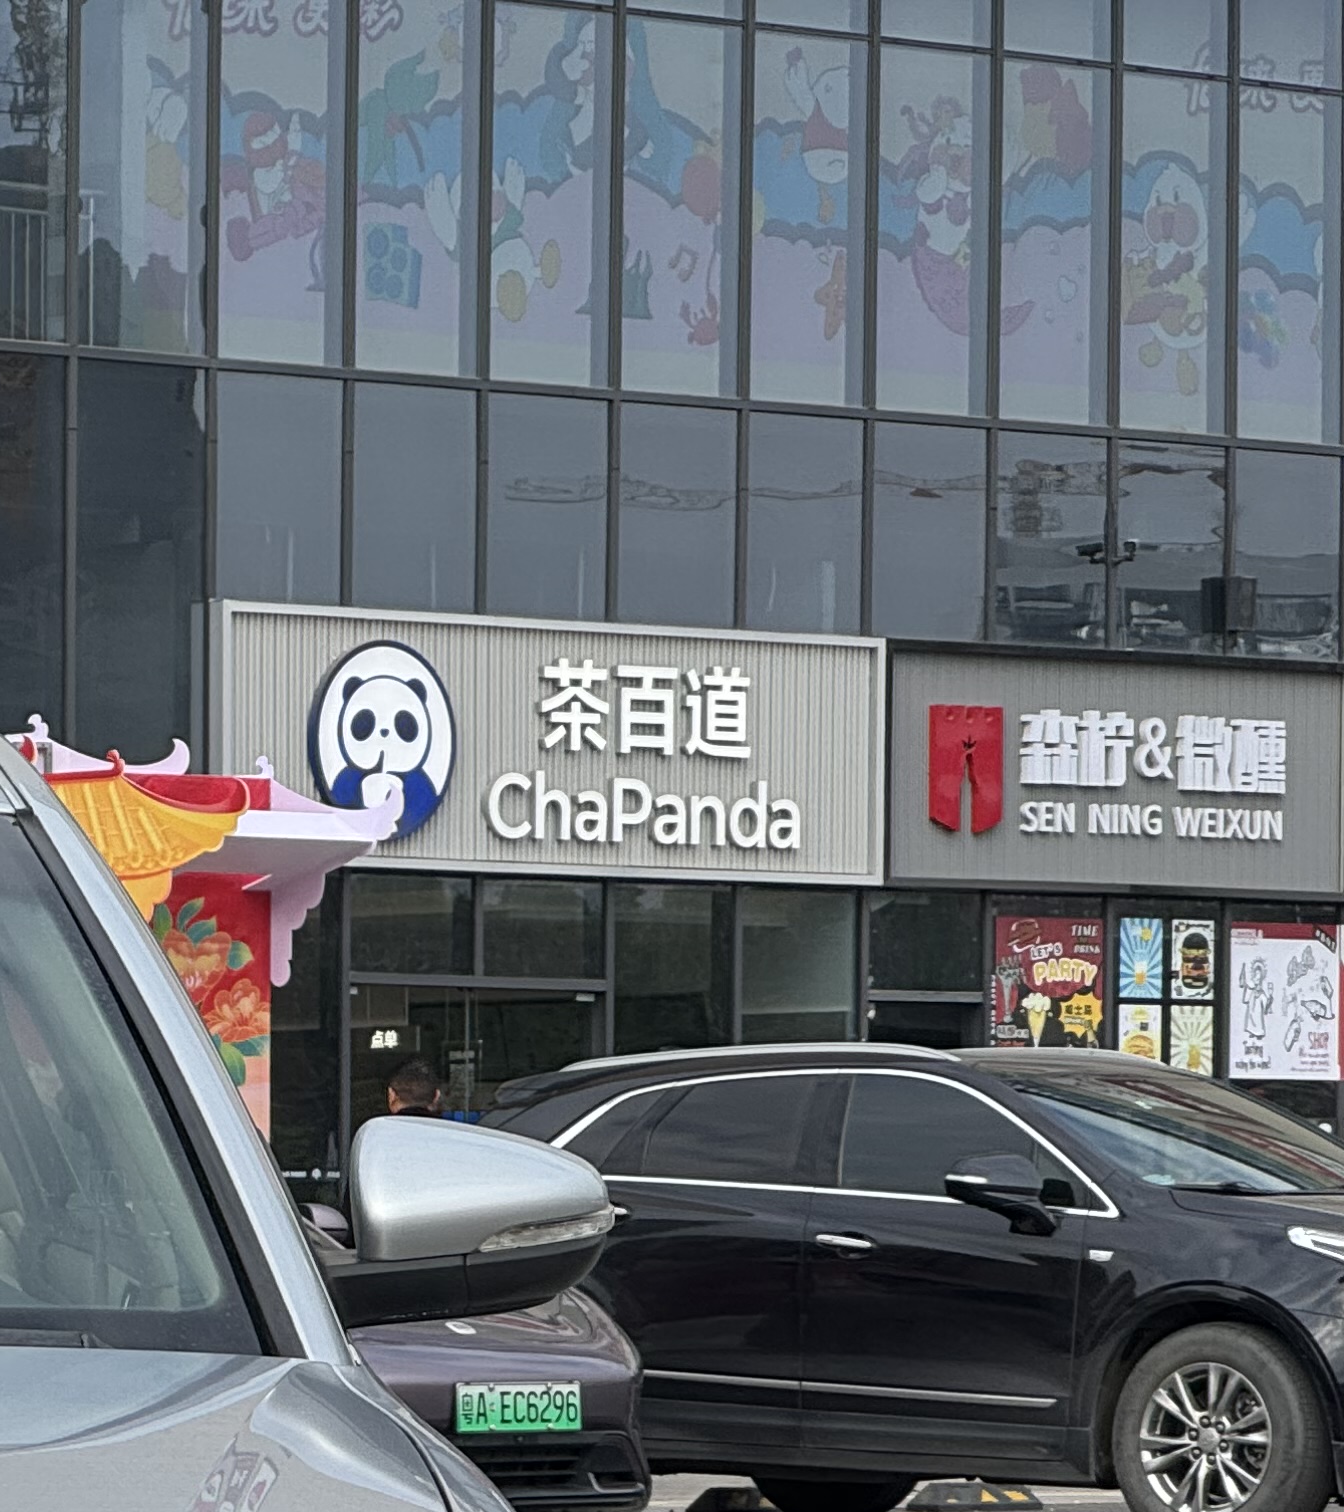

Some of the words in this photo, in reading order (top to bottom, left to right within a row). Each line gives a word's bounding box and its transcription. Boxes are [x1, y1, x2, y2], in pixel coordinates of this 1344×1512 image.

[540, 657, 752, 759] 茶百道
[486, 769, 801, 850] ChaPanda
[1019, 801, 1076, 834] SEN
[1087, 803, 1163, 836] NING
[1171, 805, 1284, 841] WEIXUN
[1071, 924, 1100, 937] TIME
[1033, 957, 1098, 987] PARTY
[370, 1029, 399, 1049] 点单
